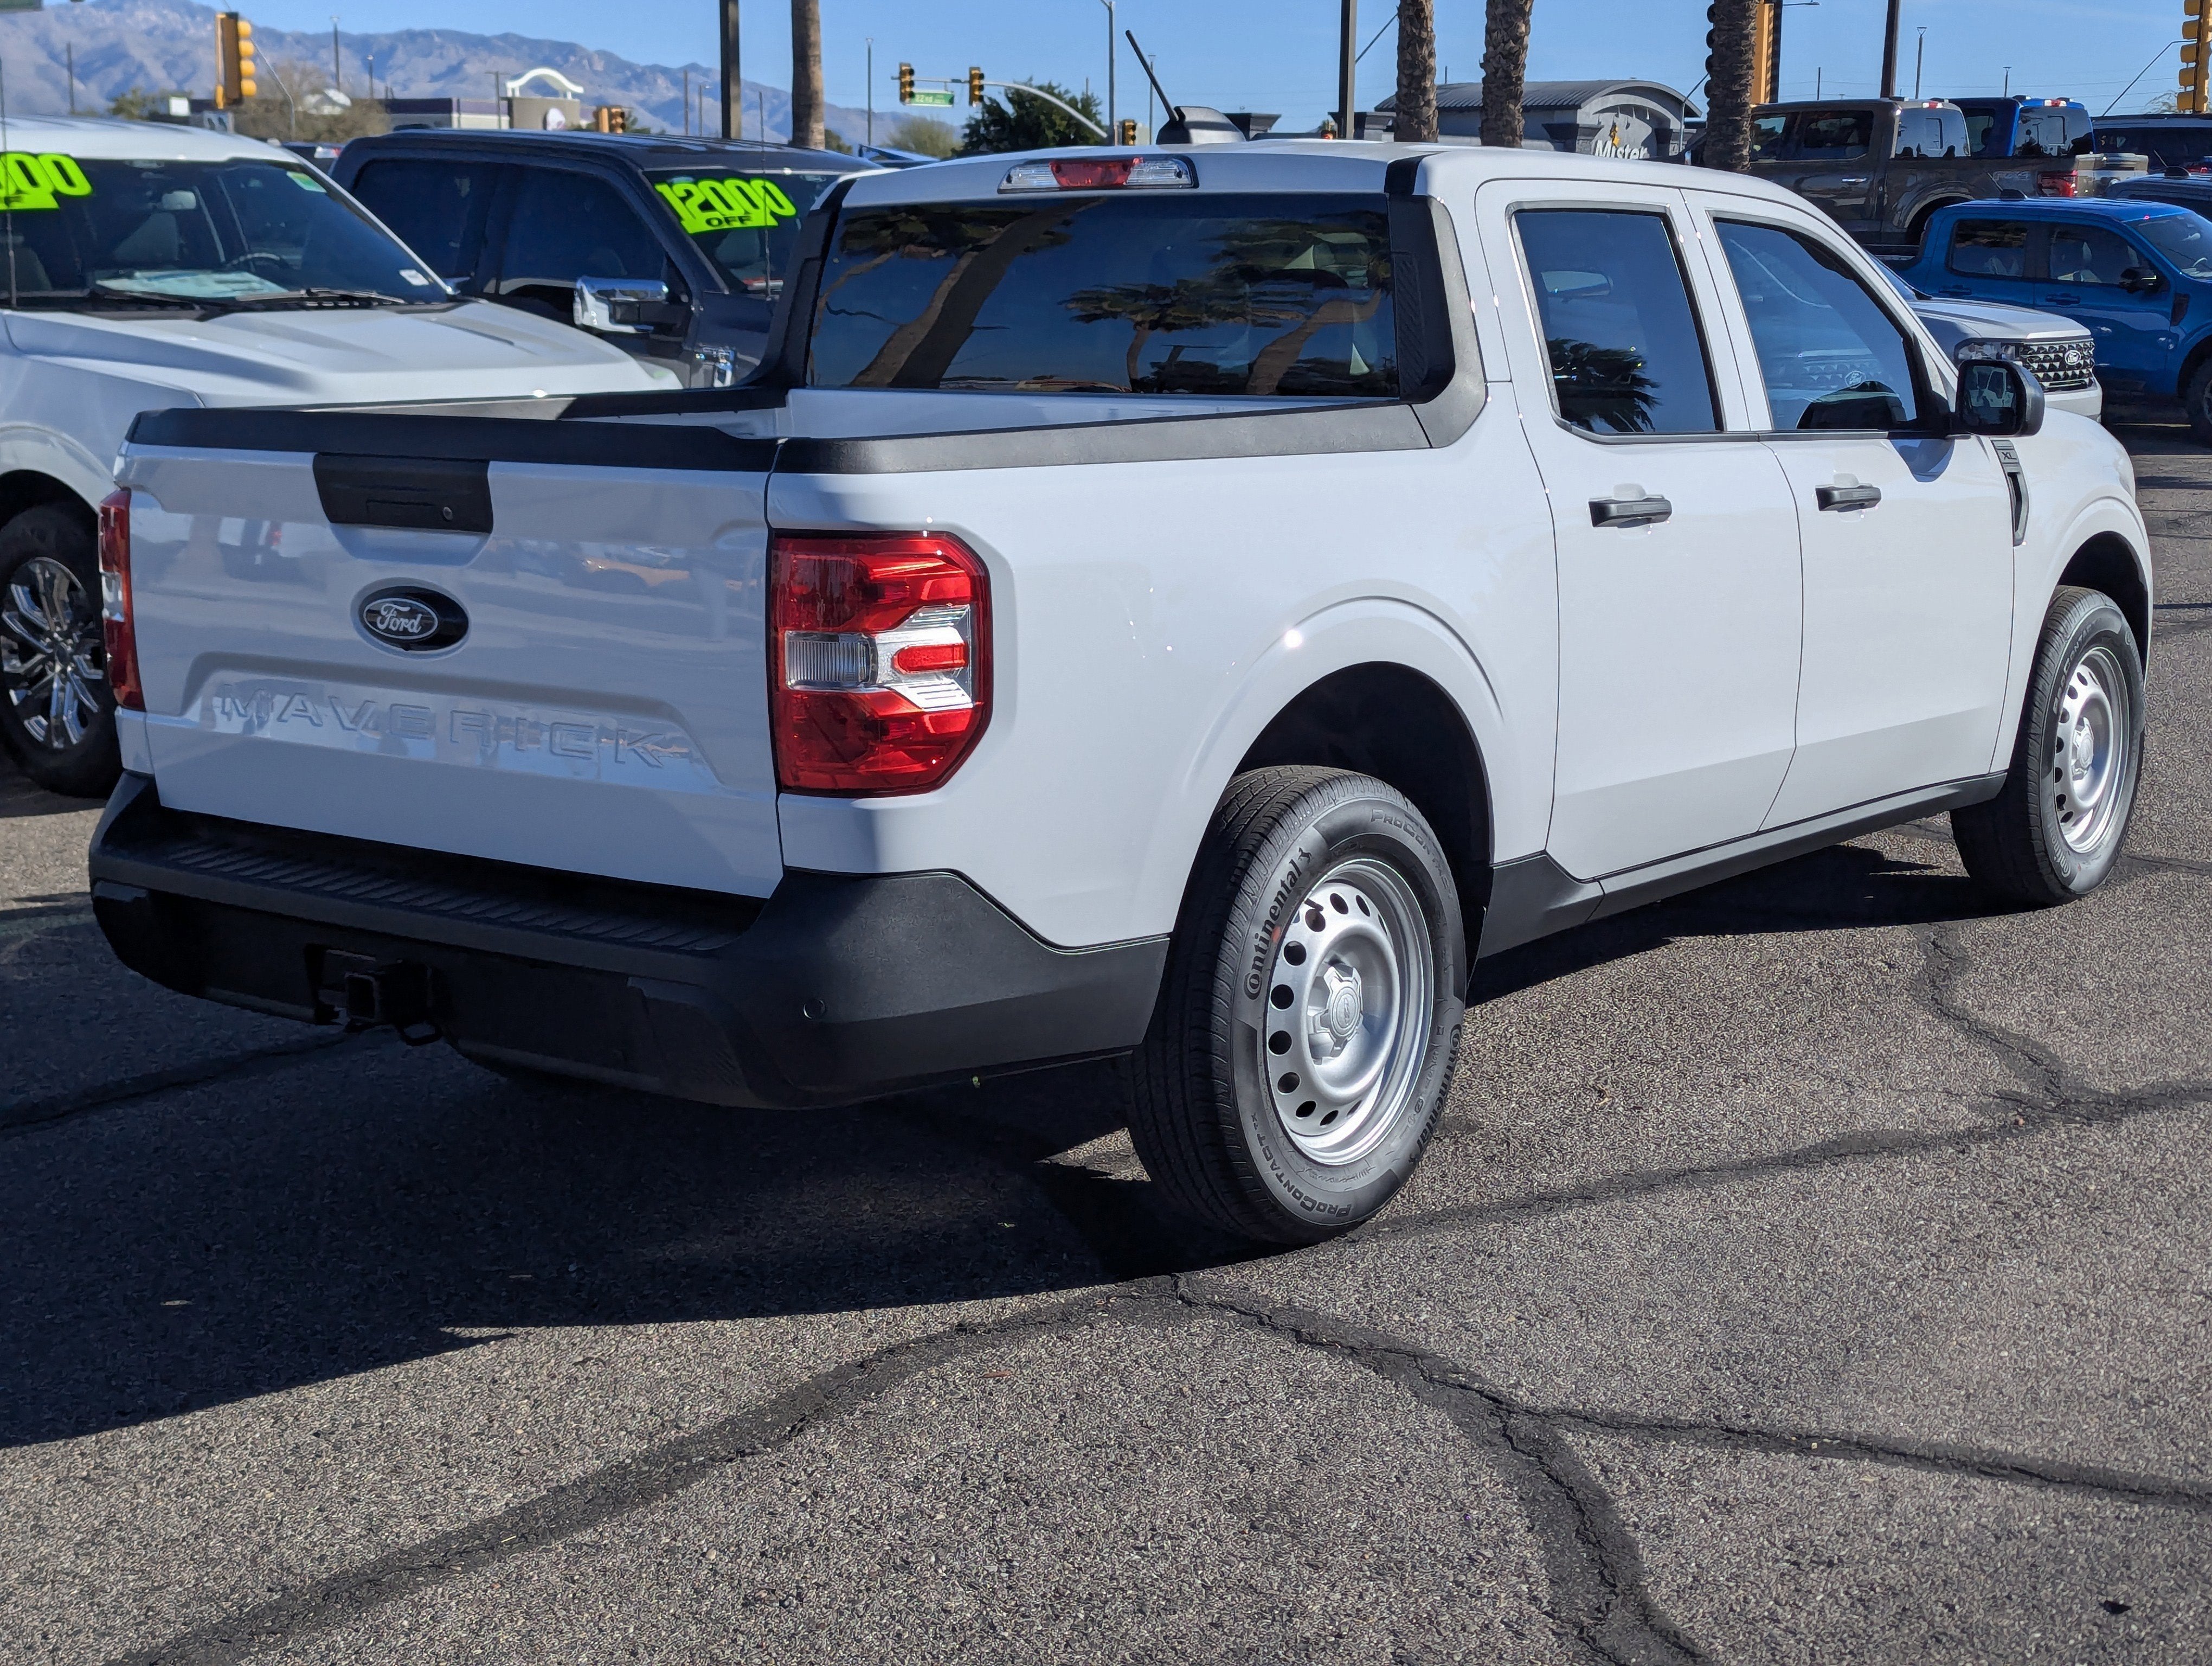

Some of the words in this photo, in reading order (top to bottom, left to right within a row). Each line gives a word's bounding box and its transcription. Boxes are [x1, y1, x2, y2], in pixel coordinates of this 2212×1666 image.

[1595, 139, 1650, 159] Mister
[655, 178, 796, 221] 12000
[705, 216, 751, 227] OFF
[2002, 451, 2017, 460] XL
[216, 683, 665, 769] MAVERICK
[1244, 859, 1302, 1000] Continental
